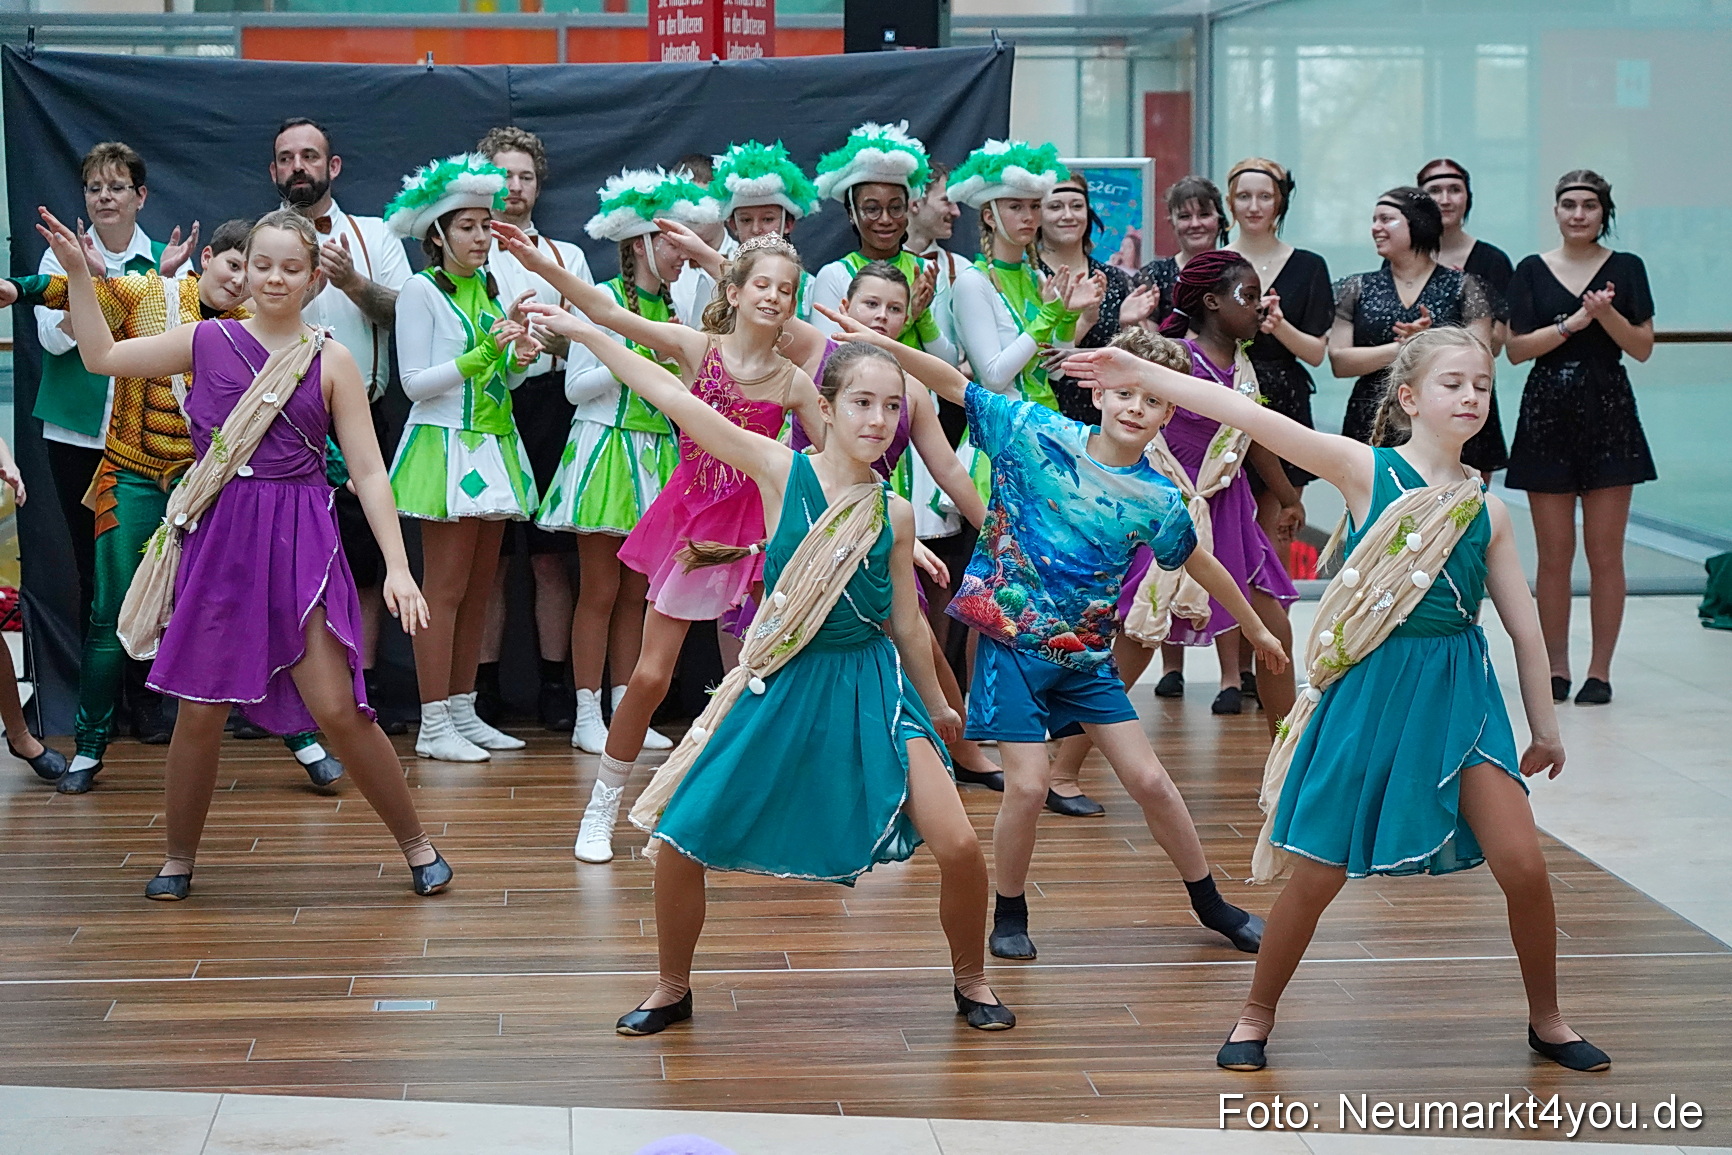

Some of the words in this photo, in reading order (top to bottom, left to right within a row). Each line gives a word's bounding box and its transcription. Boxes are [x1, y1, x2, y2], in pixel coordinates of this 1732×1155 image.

[658, 15, 666, 36] in
[666, 14, 677, 36] der
[677, 9, 703, 35] Unteren
[723, 12, 731, 33] in
[732, 12, 742, 35] der
[742, 9, 766, 36] Unteren
[661, 40, 700, 63] Ladenstraße
